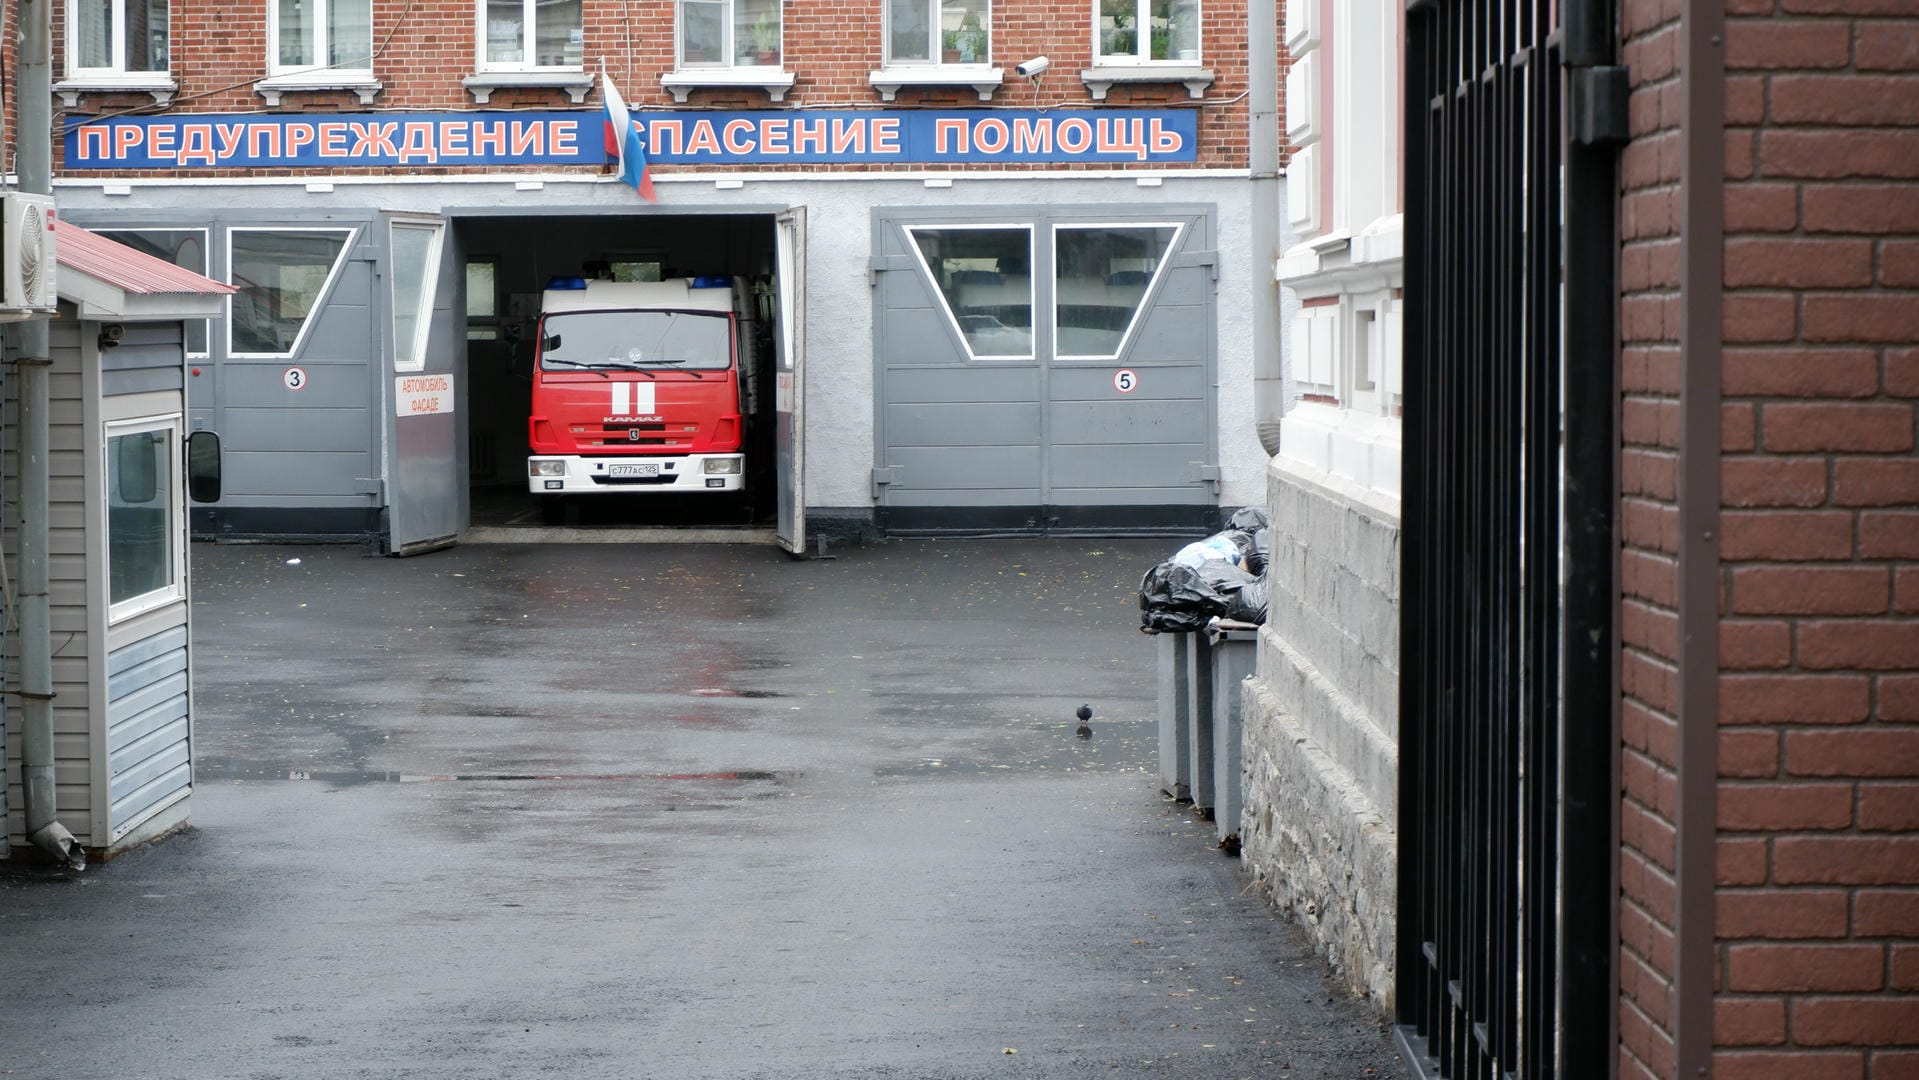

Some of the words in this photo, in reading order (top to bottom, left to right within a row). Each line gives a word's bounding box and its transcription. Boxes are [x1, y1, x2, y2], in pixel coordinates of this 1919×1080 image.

[77, 119, 579, 165] ПРЕДУПРЕЖДЕНИЕ
[934, 116, 1184, 160] ПОМОЩЬ
[290, 371, 300, 387] 3
[402, 377, 448, 393] АВТОМОБИЛЬ
[1120, 374, 1130, 389] 5
[411, 397, 439, 412] ФАСАДЕ
